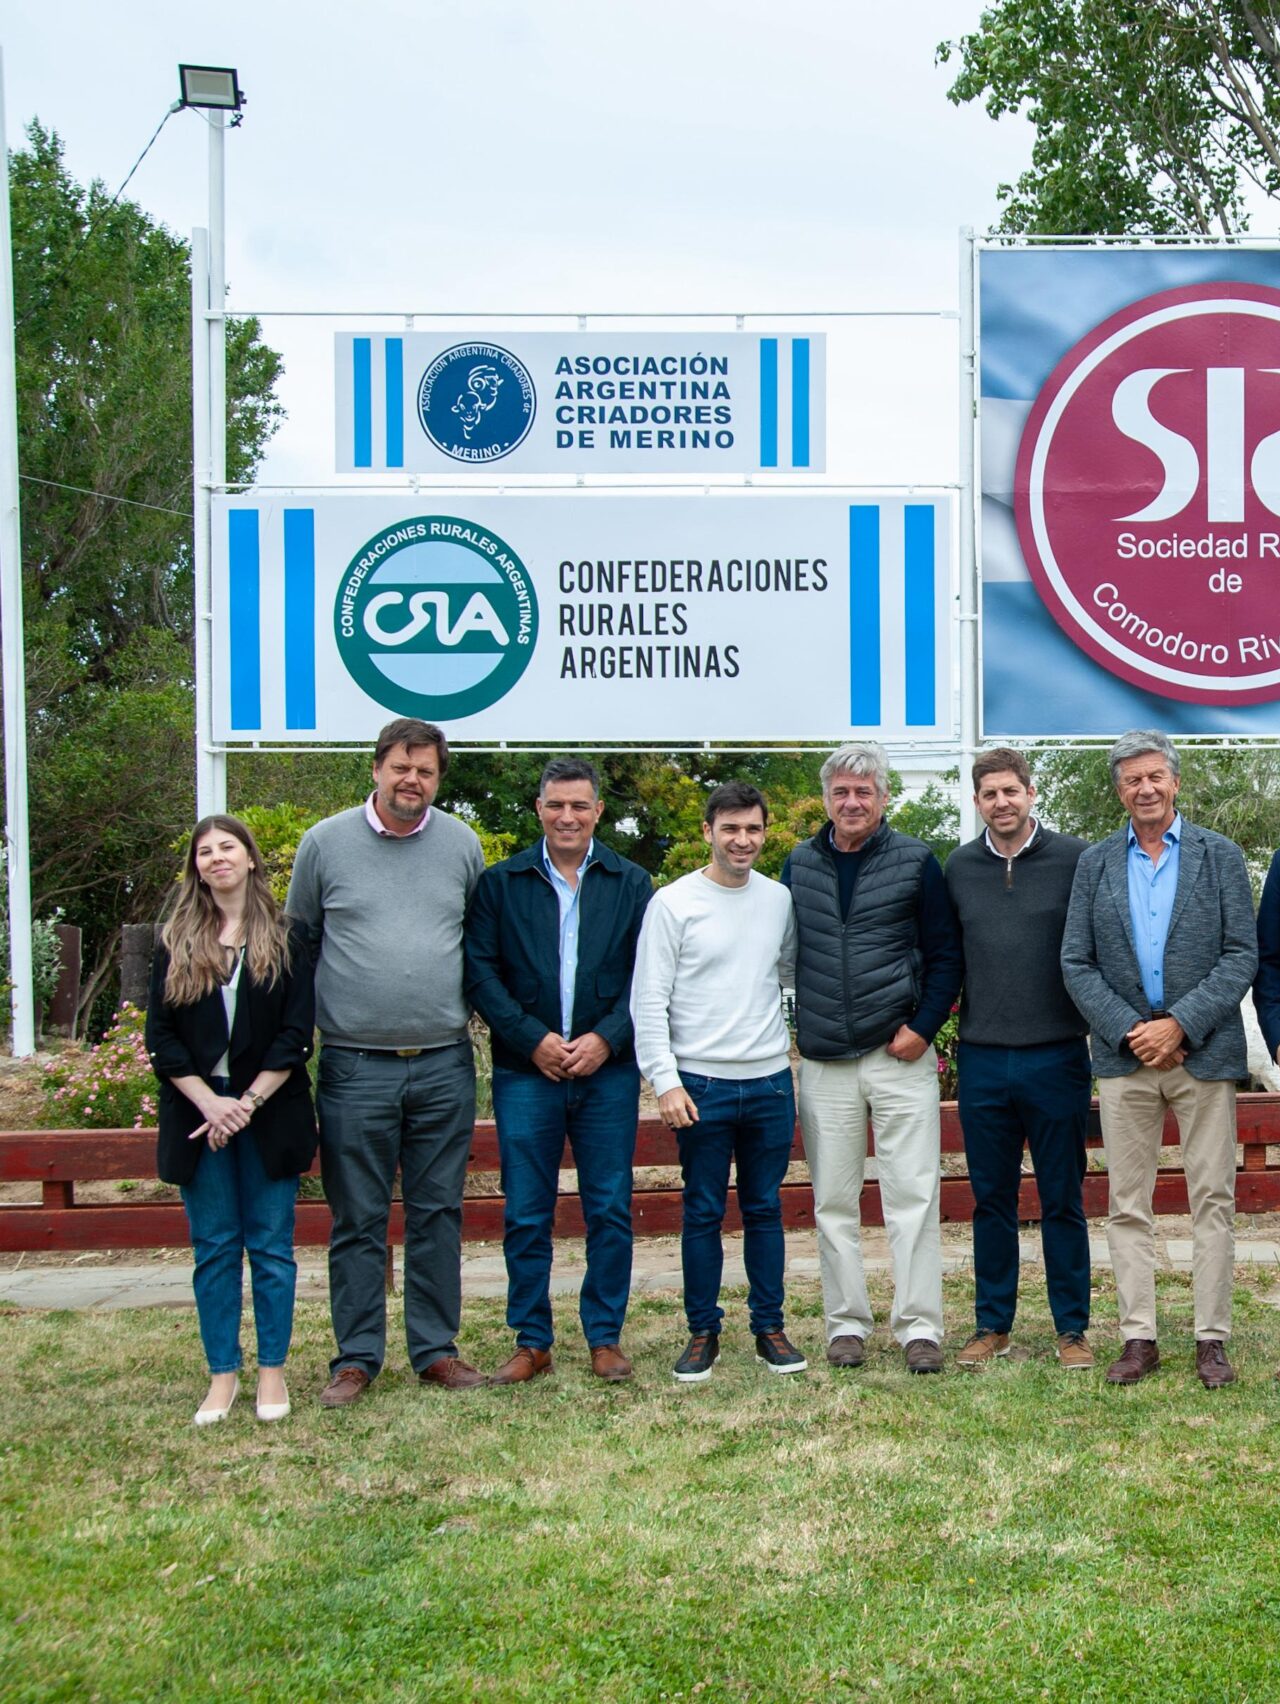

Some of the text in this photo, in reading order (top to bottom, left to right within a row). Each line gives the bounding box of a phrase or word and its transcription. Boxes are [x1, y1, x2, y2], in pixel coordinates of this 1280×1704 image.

[555, 351, 728, 375] ASOCIACIÓN
[422, 346, 532, 413] ASOCIACION ARGENTINA CRIADORES de
[555, 381, 731, 400] ARGENTINA
[555, 405, 732, 424] CRIADORES
[451, 443, 502, 459] MERINO
[556, 430, 735, 449] DE MERINO
[1116, 533, 1248, 558] Sociedad
[341, 523, 532, 645] CONFEDERACIONES RURALES ARGENTINAS
[559, 558, 828, 593] CONFEDERACIONES
[1208, 568, 1243, 593] de
[559, 603, 688, 636] RURALES
[1093, 582, 1229, 664] Comodoro
[560, 645, 740, 679] ARGENTINAS
